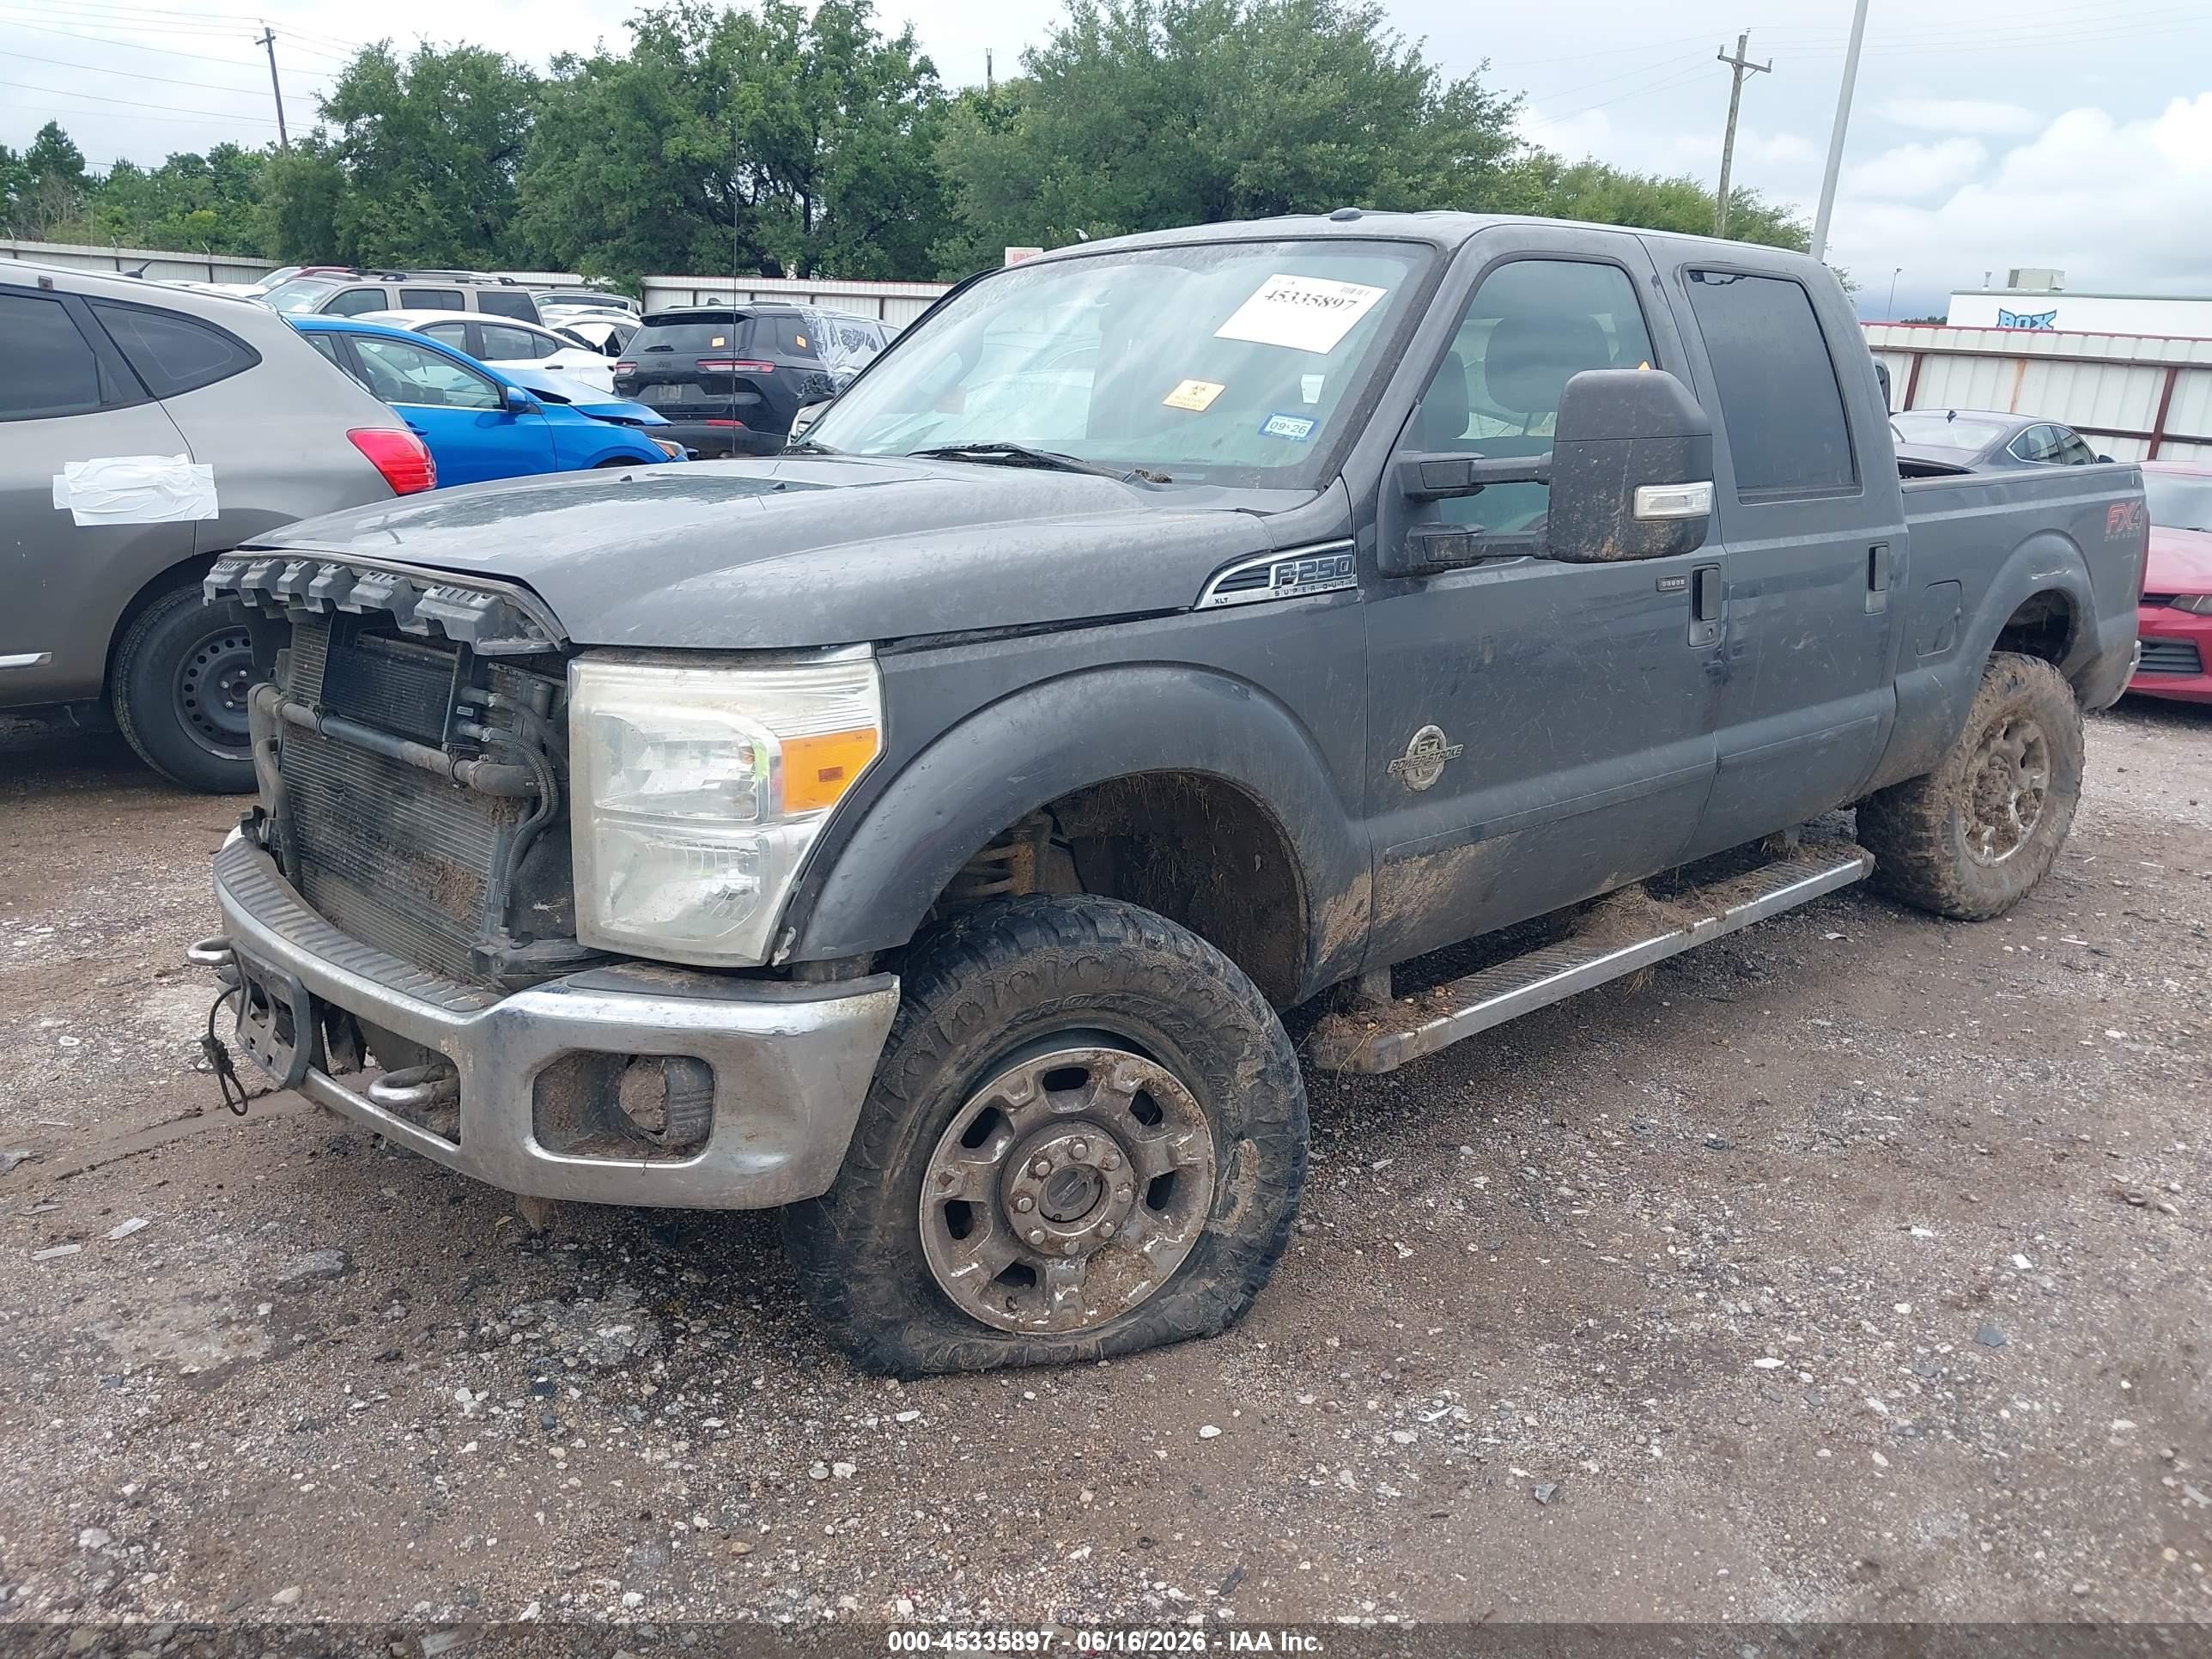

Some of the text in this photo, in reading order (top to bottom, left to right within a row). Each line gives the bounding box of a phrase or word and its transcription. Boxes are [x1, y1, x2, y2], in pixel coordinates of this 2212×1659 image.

[1264, 289, 1359, 311] 45335897
[1996, 307, 2057, 330] BOX
[1290, 424, 1308, 434] 26
[2106, 501, 2143, 534] FX4
[1270, 555, 1355, 588] F-250
[1274, 579, 1354, 597] SUPER DUTY
